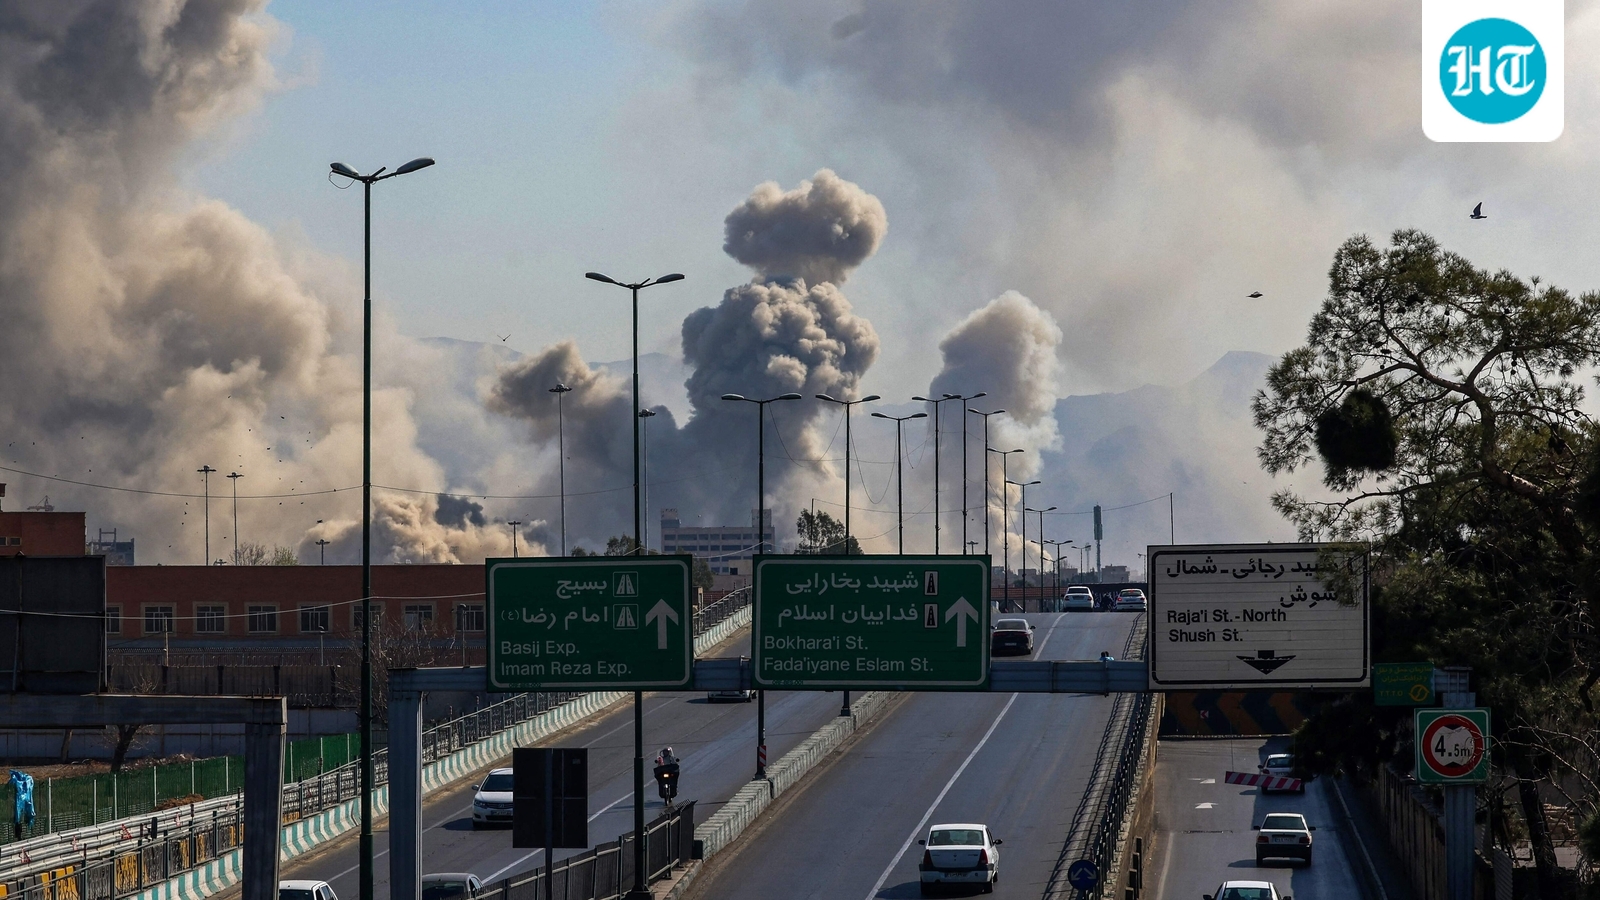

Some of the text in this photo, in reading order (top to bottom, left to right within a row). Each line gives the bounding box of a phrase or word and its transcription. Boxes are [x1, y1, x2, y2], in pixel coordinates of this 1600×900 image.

[556, 580, 607, 600] بسیج
[786, 572, 919, 596] شهید بخارایی
[565, 606, 608, 631] امام
[778, 604, 918, 628] فداییان اسلام
[1167, 609, 1208, 626] Raja'i
[764, 635, 869, 650] Bokhara'i St.
[1169, 629, 1244, 643] Shush St.
[501, 641, 580, 658] Basij Exp.
[501, 661, 632, 677] Imam Reza Exp.
[764, 657, 934, 674] Fada'iyane Eslam St.
